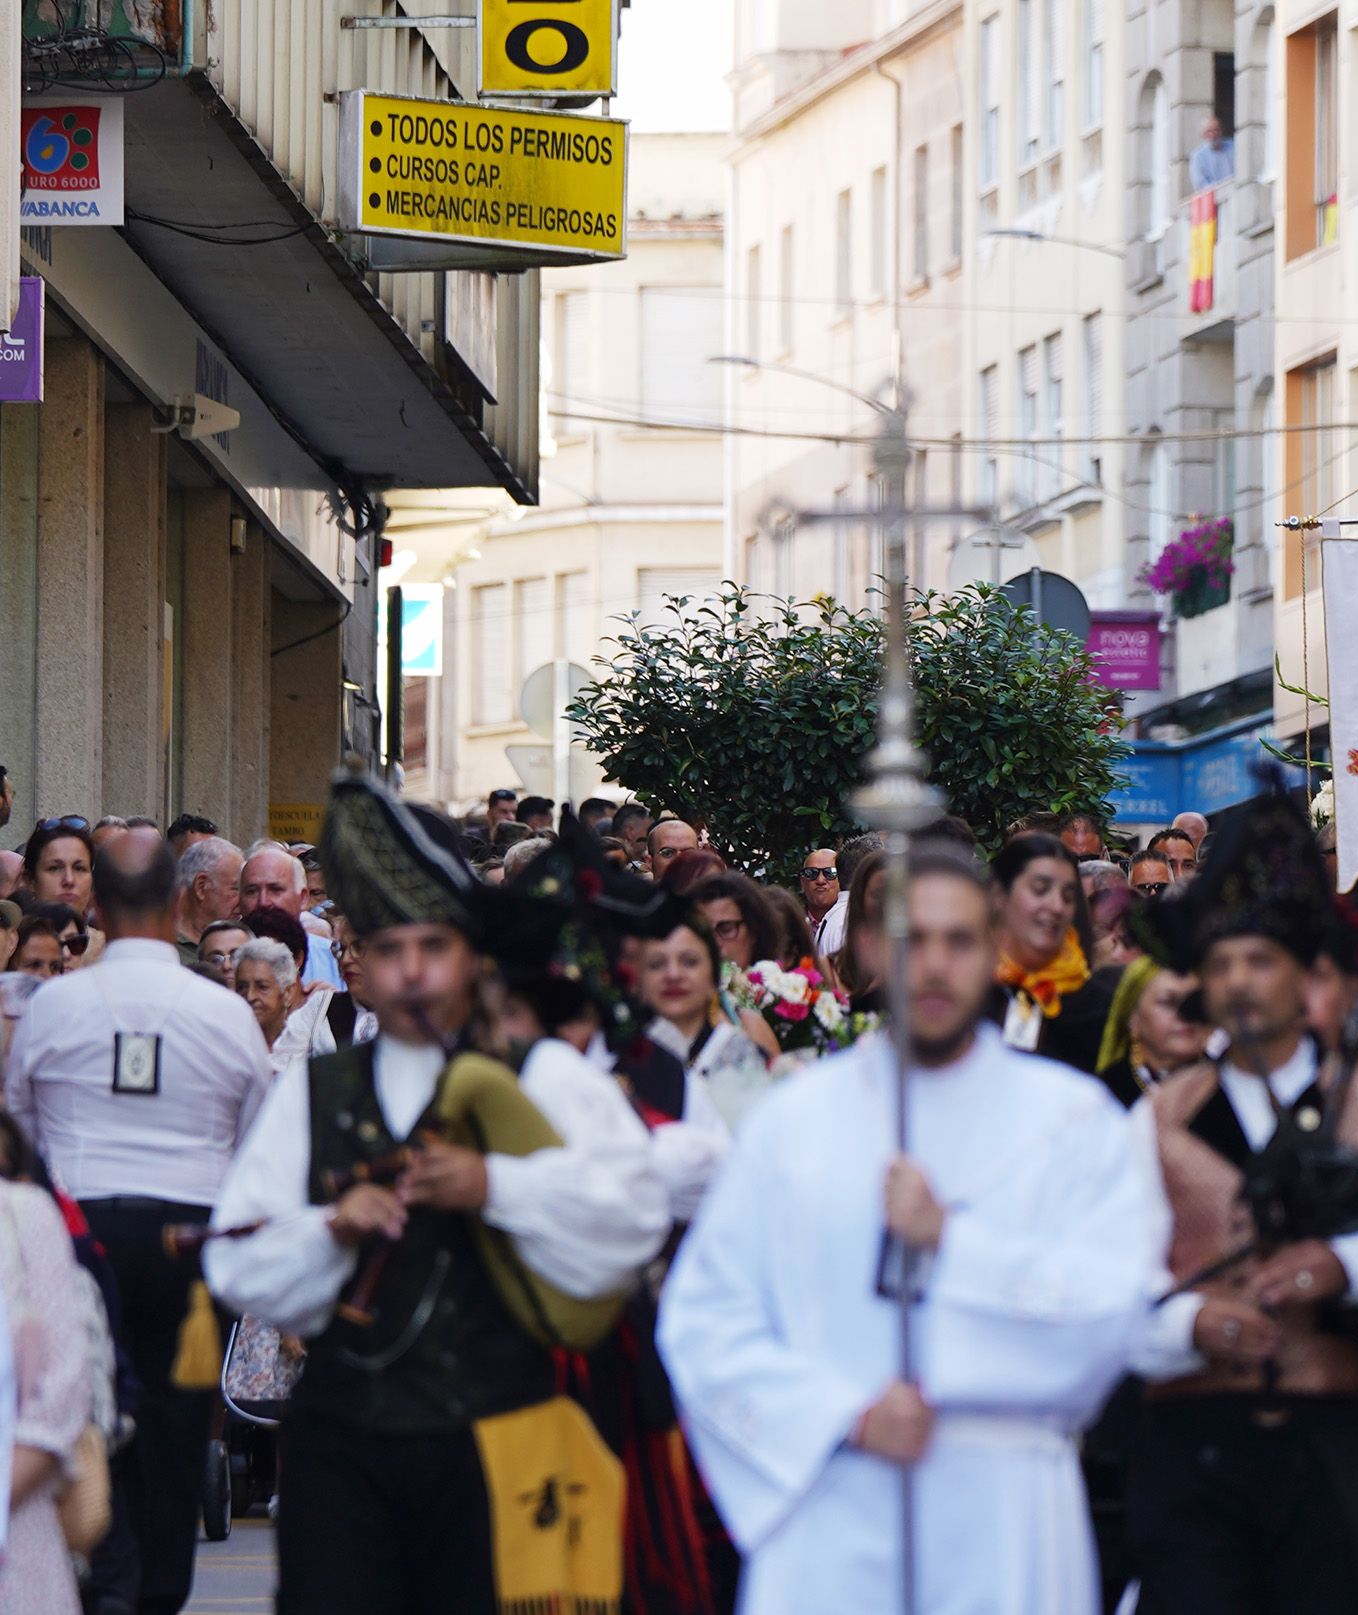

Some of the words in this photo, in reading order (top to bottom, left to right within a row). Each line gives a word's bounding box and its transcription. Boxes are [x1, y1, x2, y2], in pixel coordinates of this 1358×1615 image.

[505, 0, 589, 75] O
[388, 113, 457, 147] TODOS
[464, 121, 503, 153] LOS
[510, 126, 613, 165] PERMISOS
[61, 176, 98, 188] 6000
[387, 154, 459, 184] CURSOS
[464, 162, 502, 189] CAP.
[386, 190, 501, 225] MERCANCIAS
[506, 203, 617, 238] PELIGROSAS
